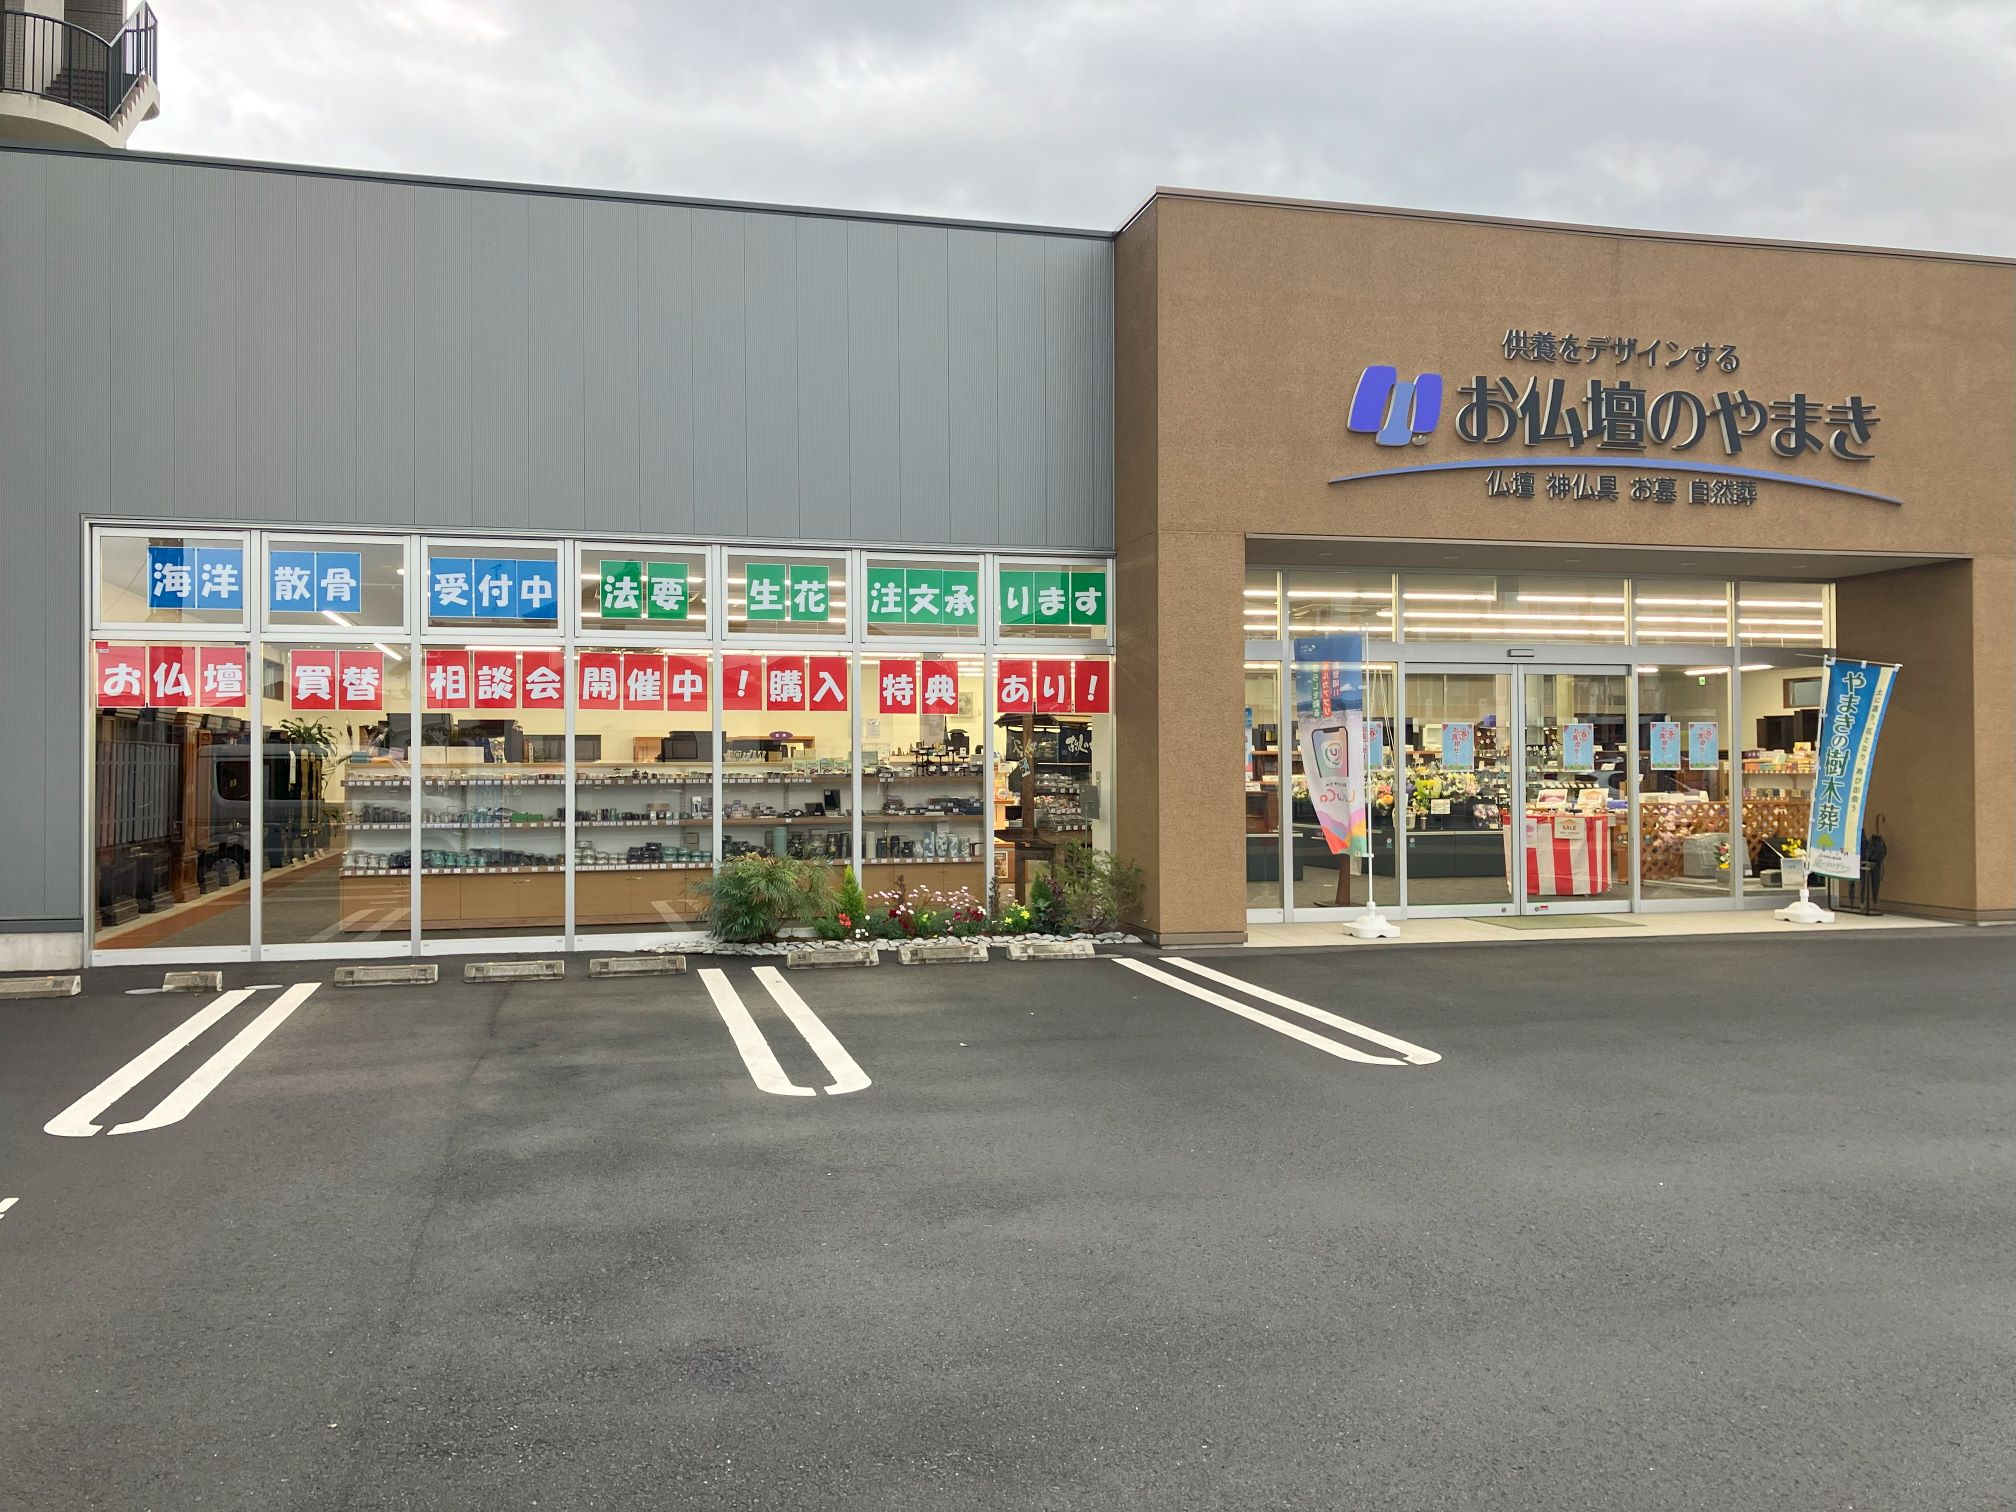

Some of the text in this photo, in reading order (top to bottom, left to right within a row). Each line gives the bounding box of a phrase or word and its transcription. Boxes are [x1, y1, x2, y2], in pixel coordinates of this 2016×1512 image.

[1502, 329, 1740, 374] 供養をデザインする
[1456, 375, 1881, 462] お仏壇のやまき
[1486, 469, 1757, 507] 仏壇 神仏具 お墓 自然葬
[1817, 671, 1867, 834] やまきの樹木葬
